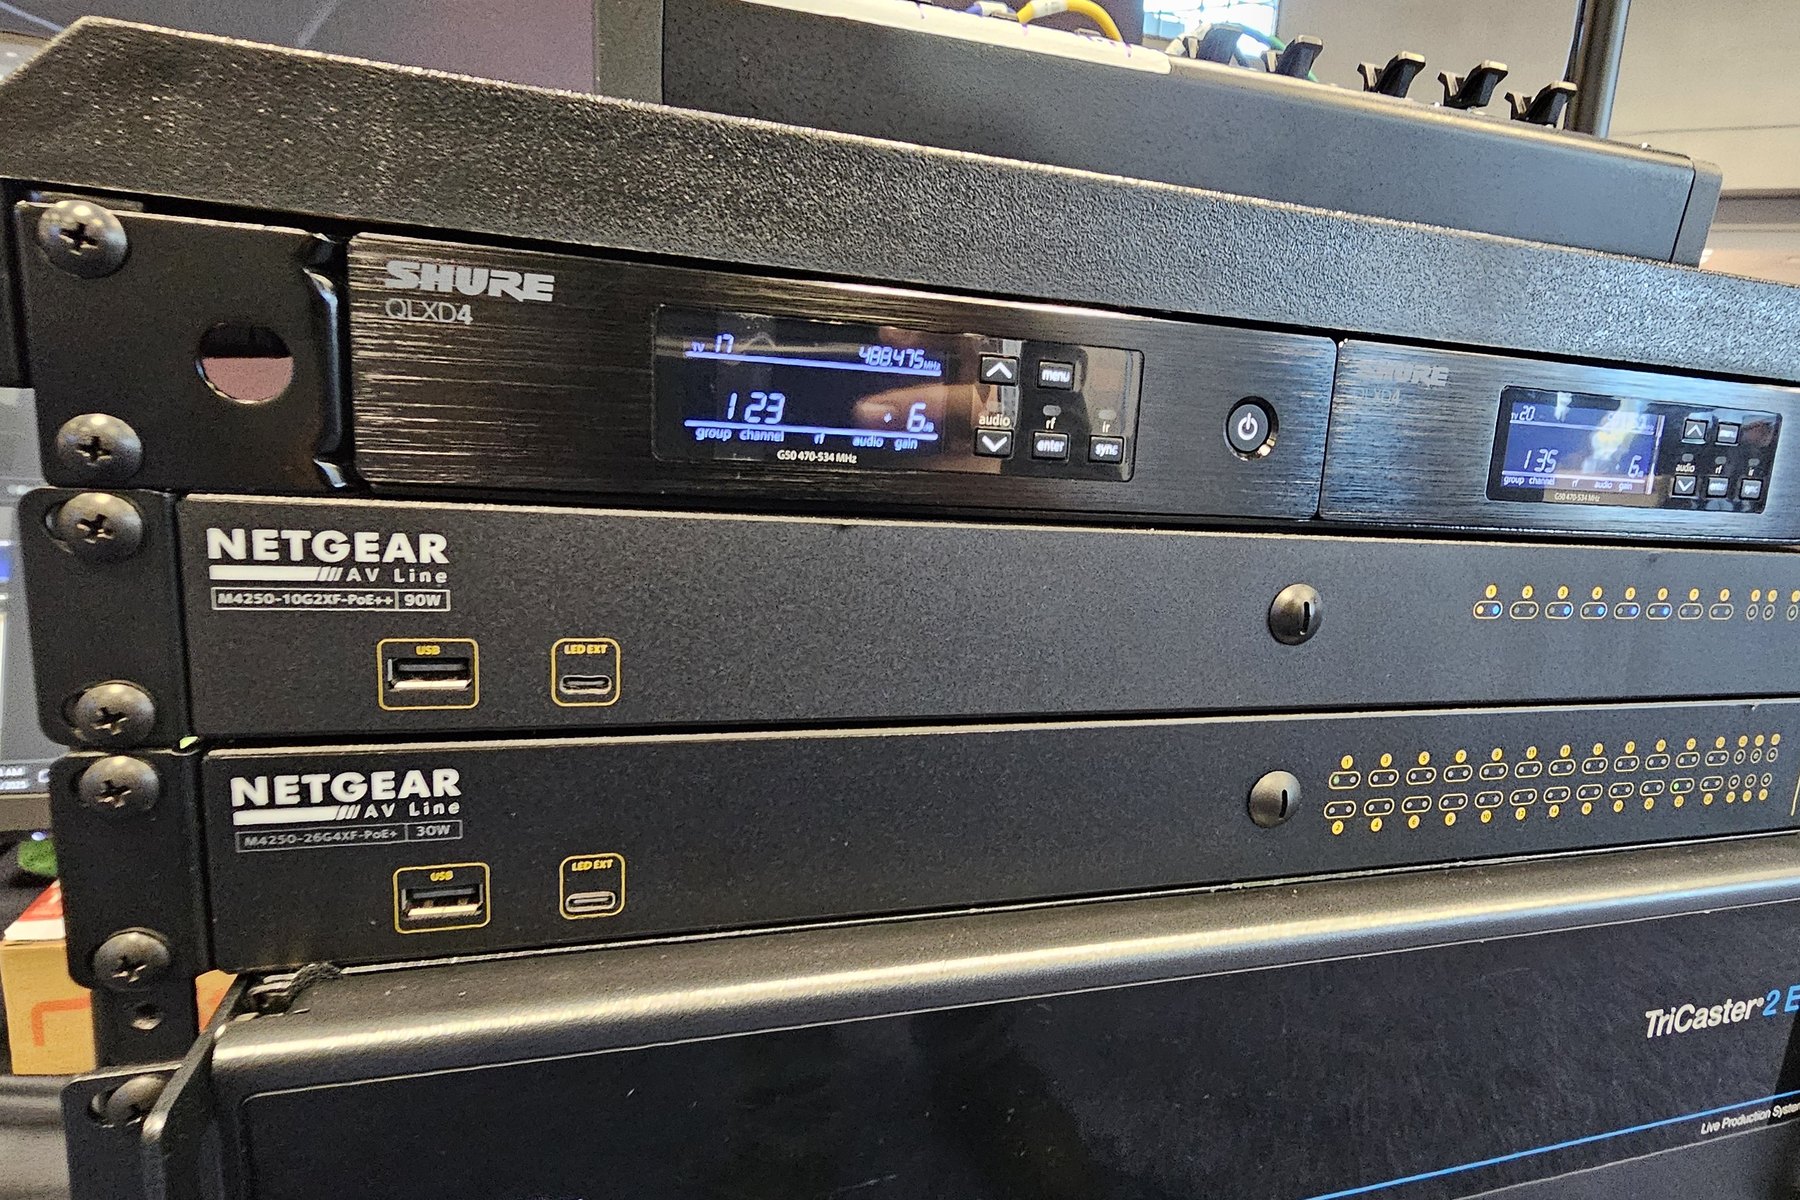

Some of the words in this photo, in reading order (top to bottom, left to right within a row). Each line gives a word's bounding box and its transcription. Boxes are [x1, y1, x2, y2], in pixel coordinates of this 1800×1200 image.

[385, 260, 555, 302] SHURE
[384, 298, 474, 325] QLXD4
[715, 333, 735, 354] 17
[1041, 369, 1071, 383] menu
[1519, 405, 1536, 421] 20
[978, 414, 1011, 428] audio
[1045, 417, 1056, 430] rf
[695, 427, 732, 442] group
[739, 429, 785, 442] channel
[814, 433, 827, 444] rf
[852, 435, 884, 448] audio
[894, 437, 918, 451] gain
[1036, 439, 1065, 452] enter
[777, 449, 797, 461] G50
[798, 450, 835, 462] 470-534
[836, 452, 858, 463] MHz
[1095, 443, 1119, 457] sync
[1675, 463, 1696, 473] audio
[1503, 476, 1525, 486] group
[1528, 475, 1556, 486] channel
[1593, 480, 1613, 489] audio
[206, 527, 450, 564] NETGEAR
[346, 567, 380, 582] AV
[394, 567, 448, 583] Line
[217, 593, 394, 606] M4250-10G2XF-PoE++
[404, 593, 442, 607] 90W
[415, 645, 441, 656] USB
[564, 644, 584, 655] LED
[586, 644, 608, 654] EXT
[230, 768, 462, 807] NETGEAR
[363, 802, 396, 819] AV
[409, 801, 461, 817] Line
[416, 825, 451, 837] 30W
[571, 861, 592, 872] LED
[593, 858, 613, 870] EXT
[430, 870, 454, 882] USB
[1762, 989, 1781, 1016] 2
[1701, 1122, 1720, 1135] Live
[1722, 1108, 1771, 1130] Production
